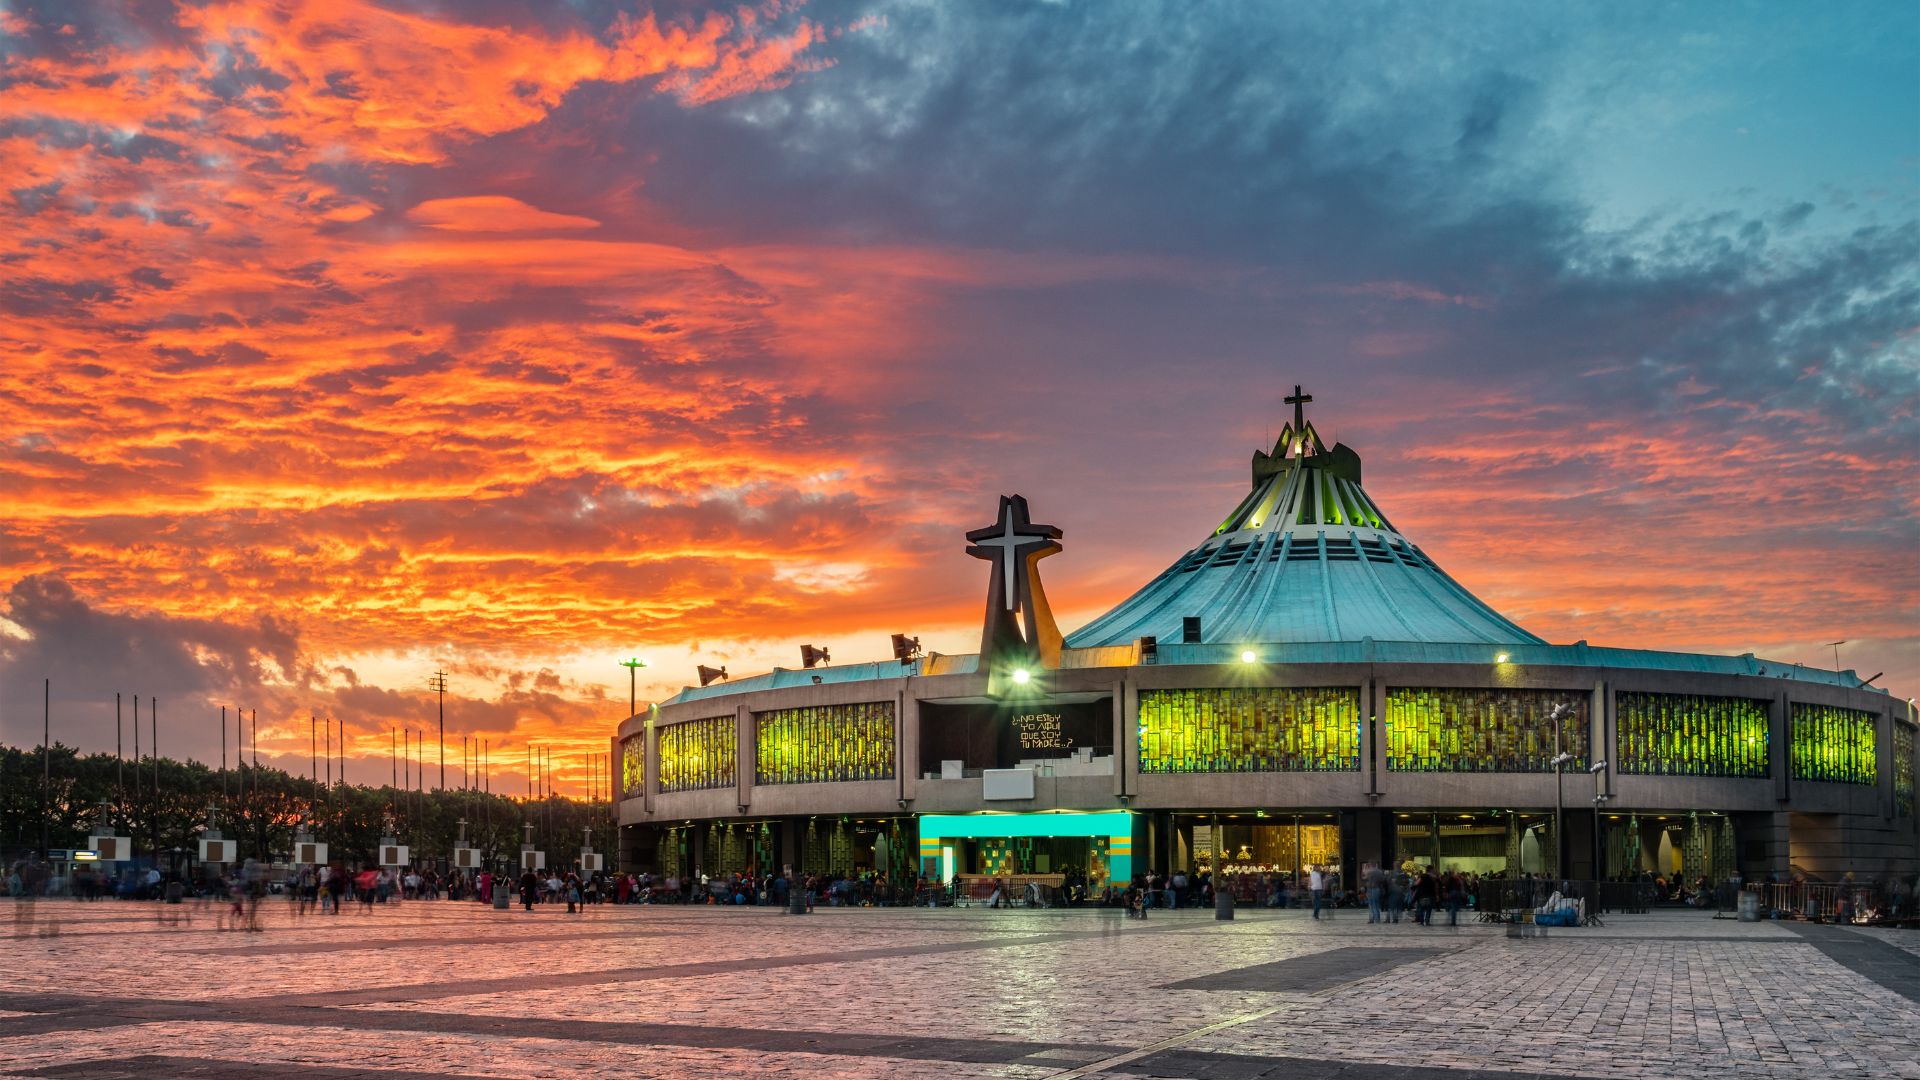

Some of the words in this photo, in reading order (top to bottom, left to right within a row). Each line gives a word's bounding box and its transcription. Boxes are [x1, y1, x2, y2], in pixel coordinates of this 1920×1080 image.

[1036, 714, 1060, 722] ESTOY
[1041, 731, 1061, 739] SOY
[1021, 740, 1030, 748] TU
